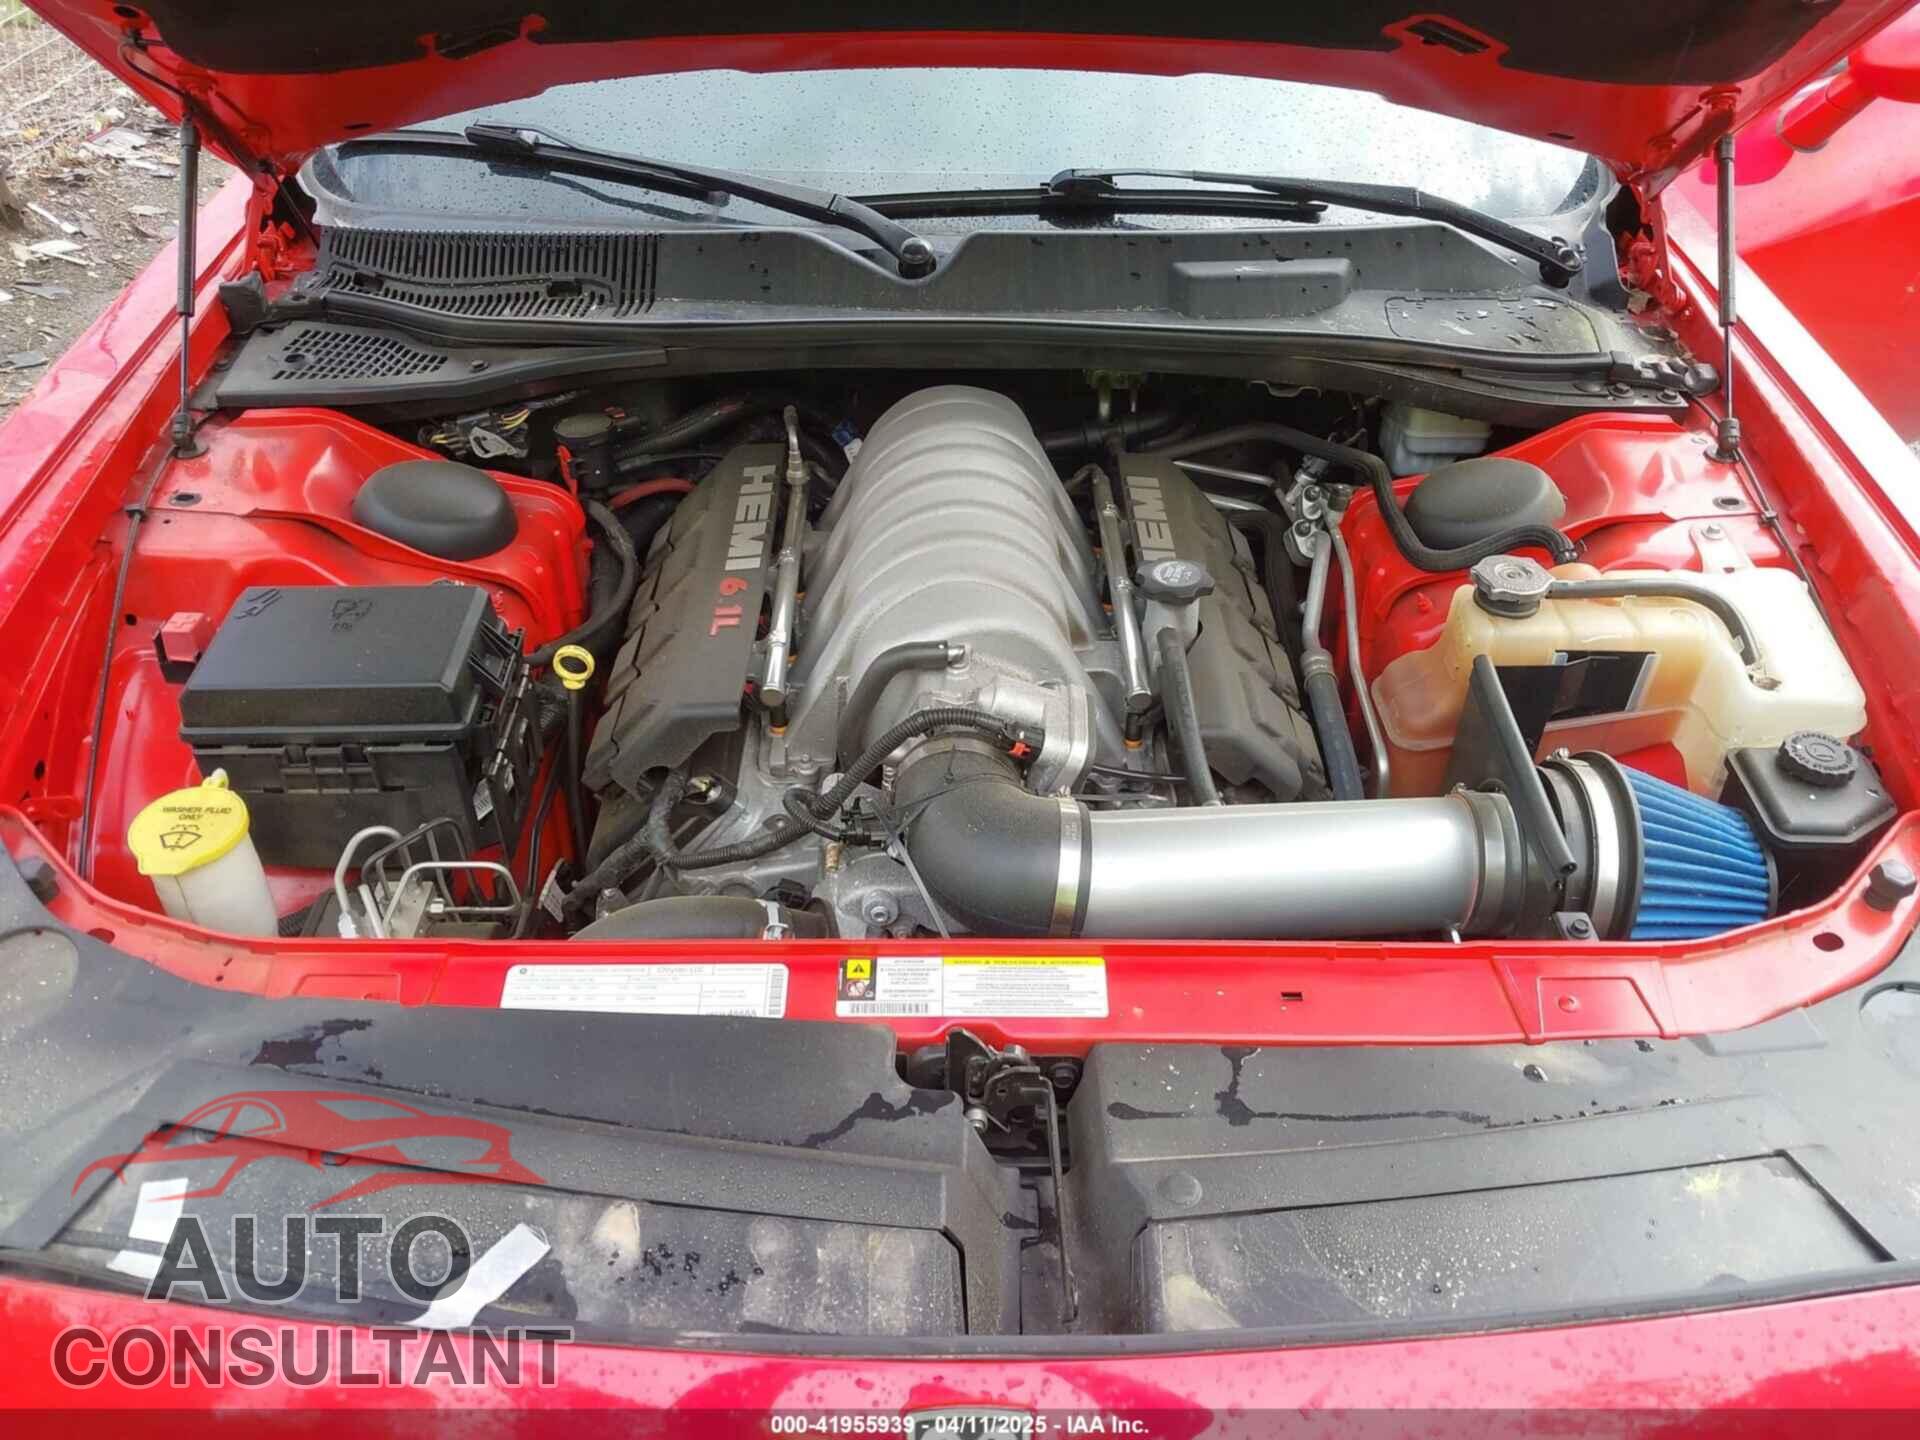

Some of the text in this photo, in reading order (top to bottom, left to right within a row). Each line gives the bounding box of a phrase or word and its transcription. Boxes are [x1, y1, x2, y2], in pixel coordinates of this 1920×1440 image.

[724, 465, 776, 571] HEMI
[1126, 475, 1177, 561] EMI
[204, 806, 232, 814] FLUID
